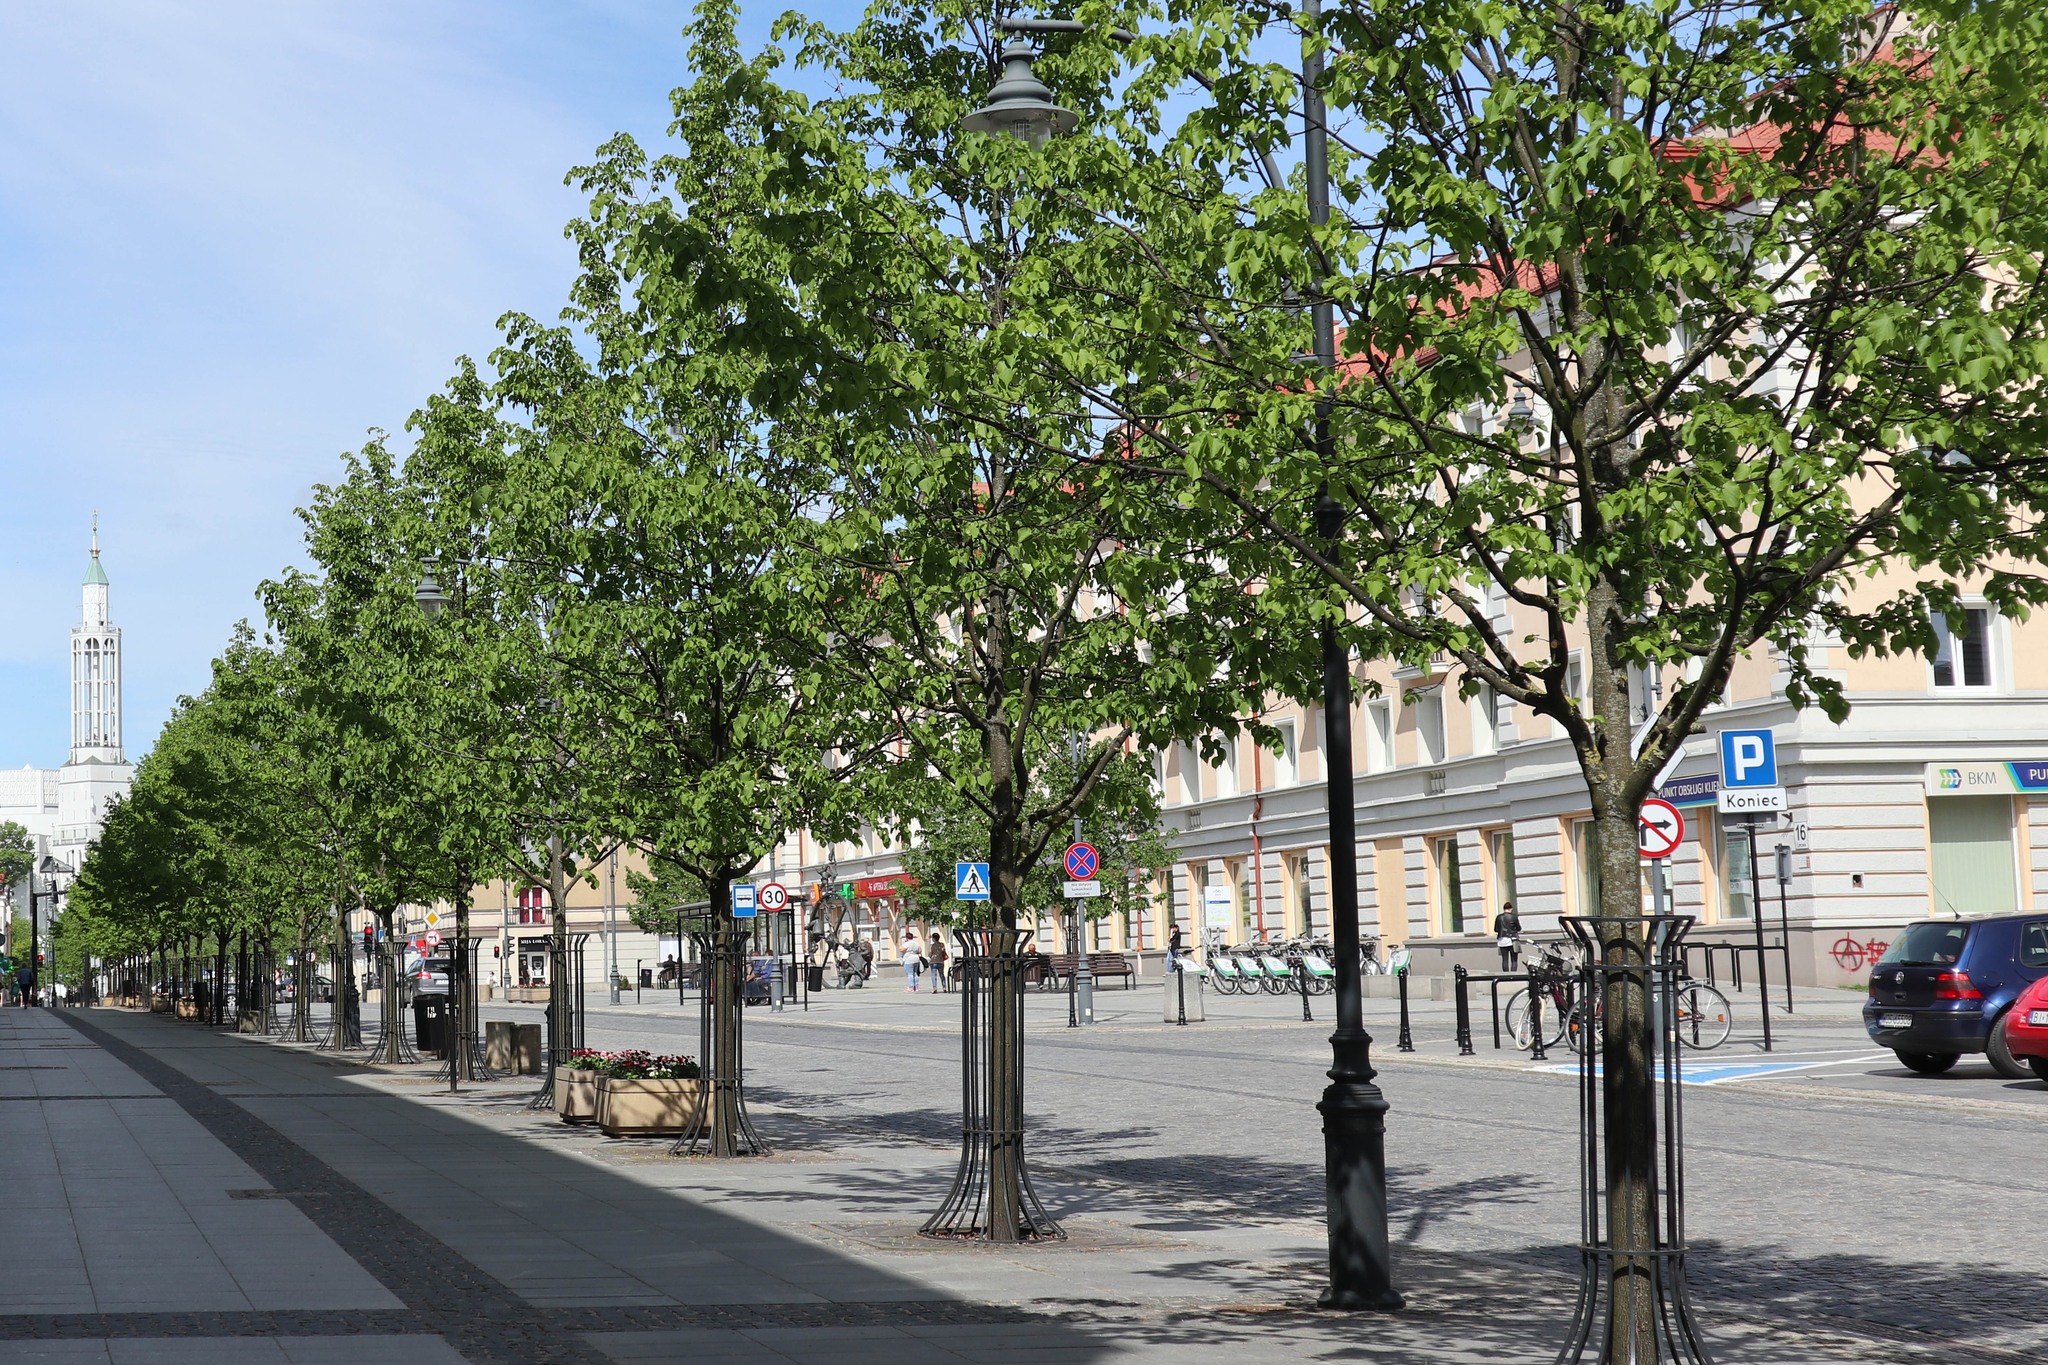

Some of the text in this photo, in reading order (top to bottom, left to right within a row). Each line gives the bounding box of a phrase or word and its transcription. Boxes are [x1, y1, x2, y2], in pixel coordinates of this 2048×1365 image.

[1733, 736, 1764, 780] P
[1968, 772, 1997, 785] BKM
[2029, 768, 2048, 780] PU
[1678, 783, 1704, 796] OBSŁUGI
[1726, 793, 1779, 808] Koniec
[1795, 824, 1807, 841] 16
[764, 890, 784, 904] 30
